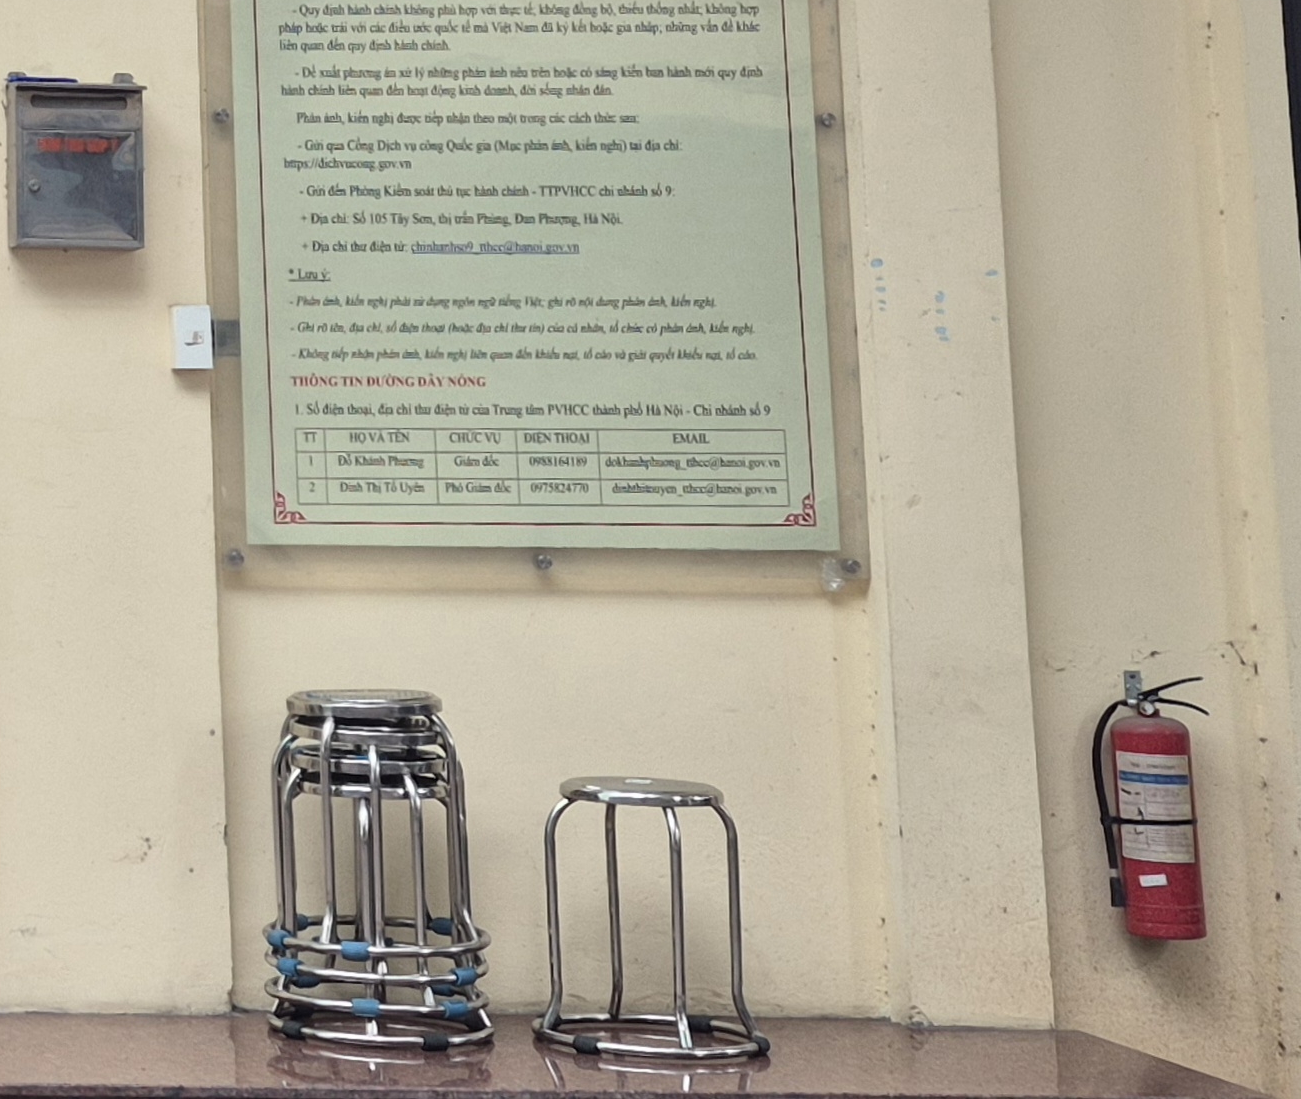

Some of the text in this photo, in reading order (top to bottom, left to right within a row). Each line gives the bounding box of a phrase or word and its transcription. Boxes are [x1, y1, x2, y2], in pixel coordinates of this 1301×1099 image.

[290, 373, 485, 387] THÔNG TIN ĐƯỜNG DÂY NÓNG
[302, 431, 317, 442] TT
[349, 432, 366, 444] HỌ
[368, 430, 385, 442] VÀ
[484, 432, 500, 444] VỤ
[553, 432, 589, 444] THOẠI
[672, 433, 709, 443] EMAIL
[308, 455, 312, 466] 1
[453, 454, 499, 466] Giám đốc
[309, 481, 315, 492] 2
[445, 482, 463, 493] Phó
[494, 480, 512, 493] đốc
